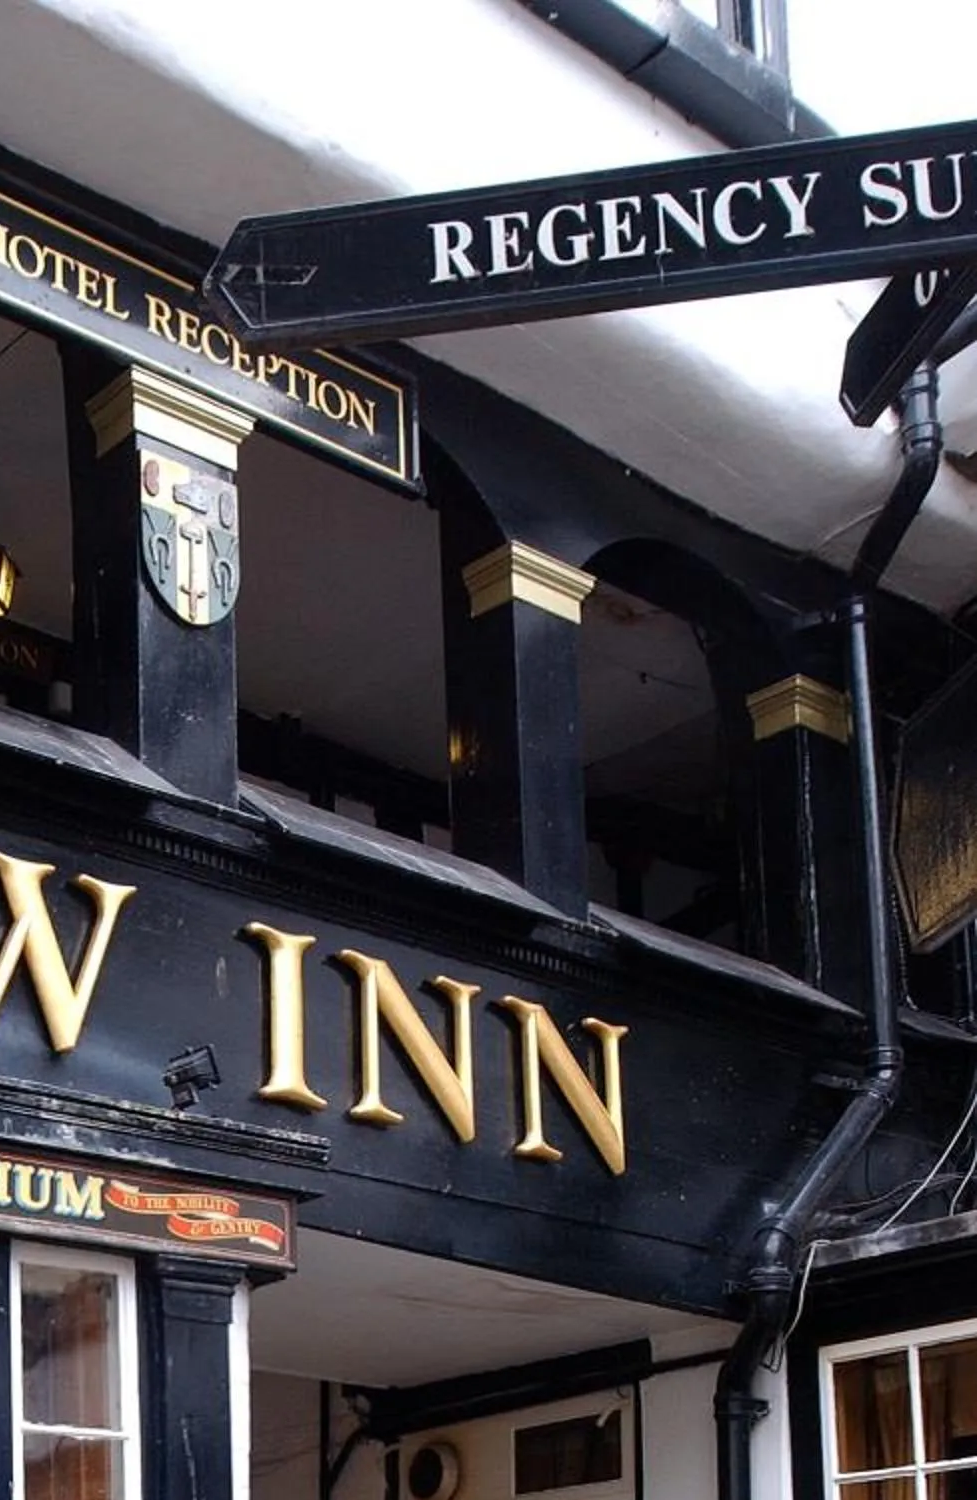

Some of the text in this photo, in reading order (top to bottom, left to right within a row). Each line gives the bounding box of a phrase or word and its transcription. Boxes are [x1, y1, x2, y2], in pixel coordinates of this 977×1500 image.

[428, 152, 977, 284] REGENCY SU
[145, 293, 376, 436] RECEPTION
[239, 921, 629, 1176] INN
[146, 1196, 171, 1209] THE
[210, 1221, 260, 1235] GENTRY
